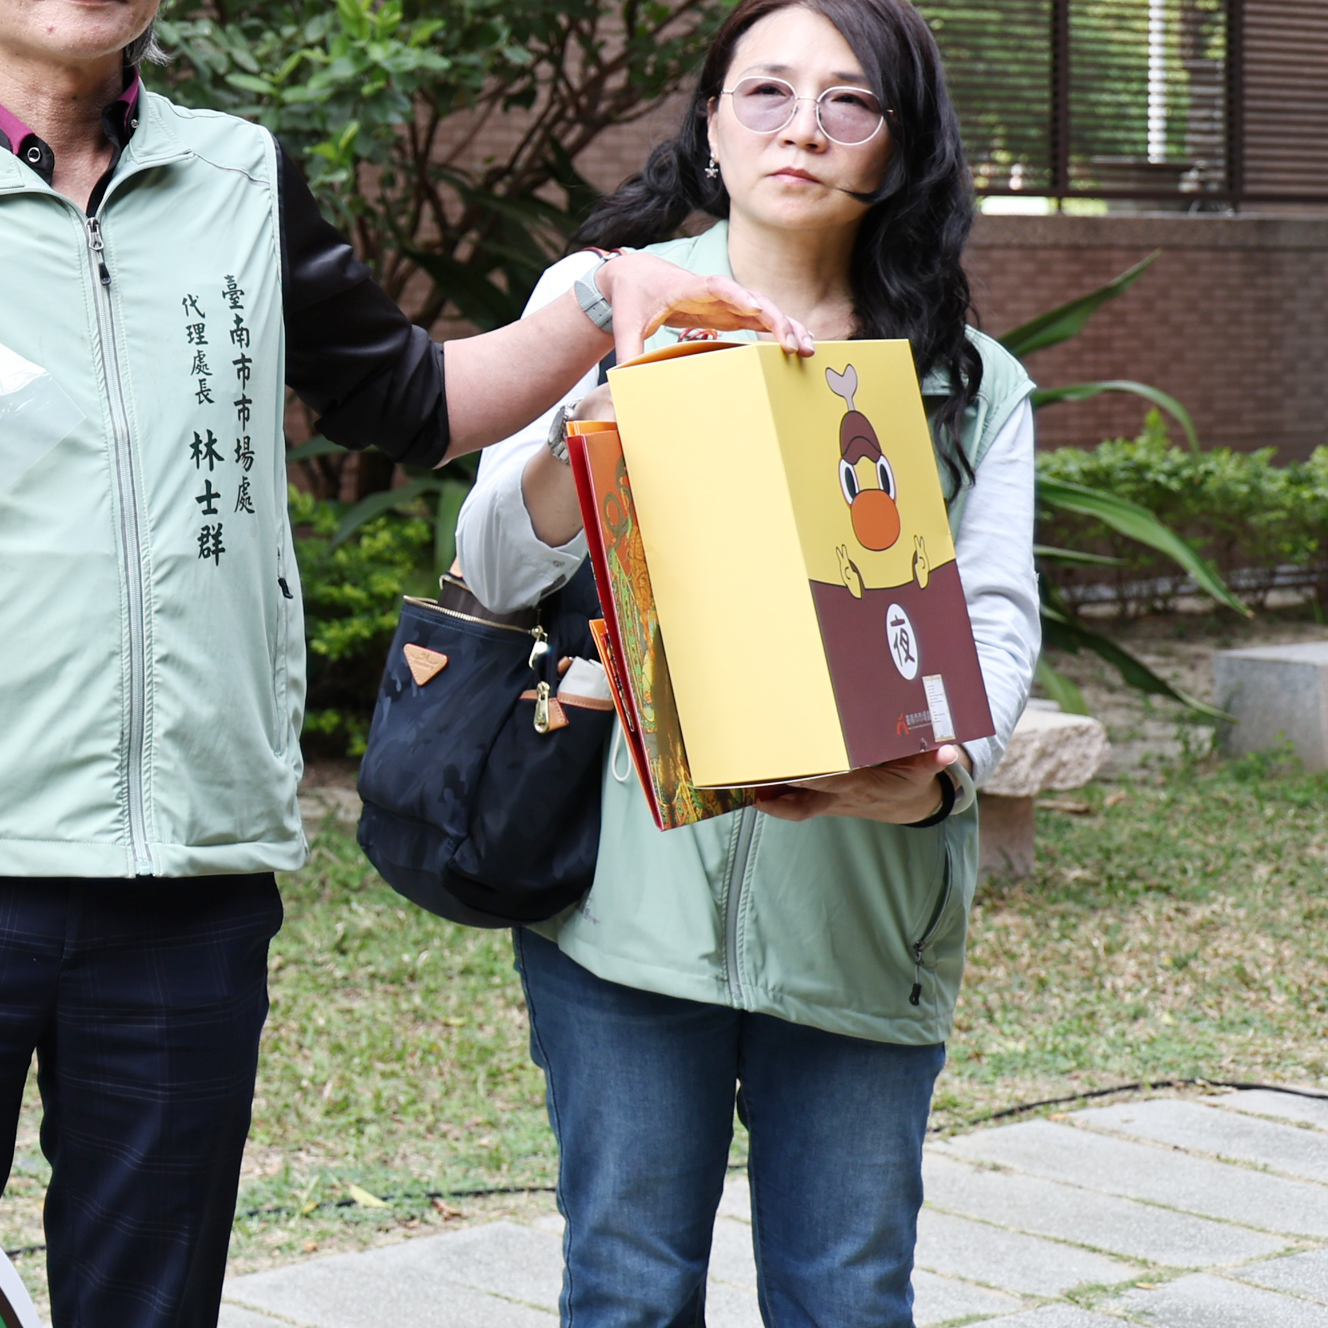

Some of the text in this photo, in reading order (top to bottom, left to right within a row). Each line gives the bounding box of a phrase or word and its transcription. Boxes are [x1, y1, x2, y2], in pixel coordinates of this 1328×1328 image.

[181, 293, 225, 566] 代理處長 林士群
[222, 274, 255, 514] 臺南市市場處
[890, 615, 915, 667] 夜
